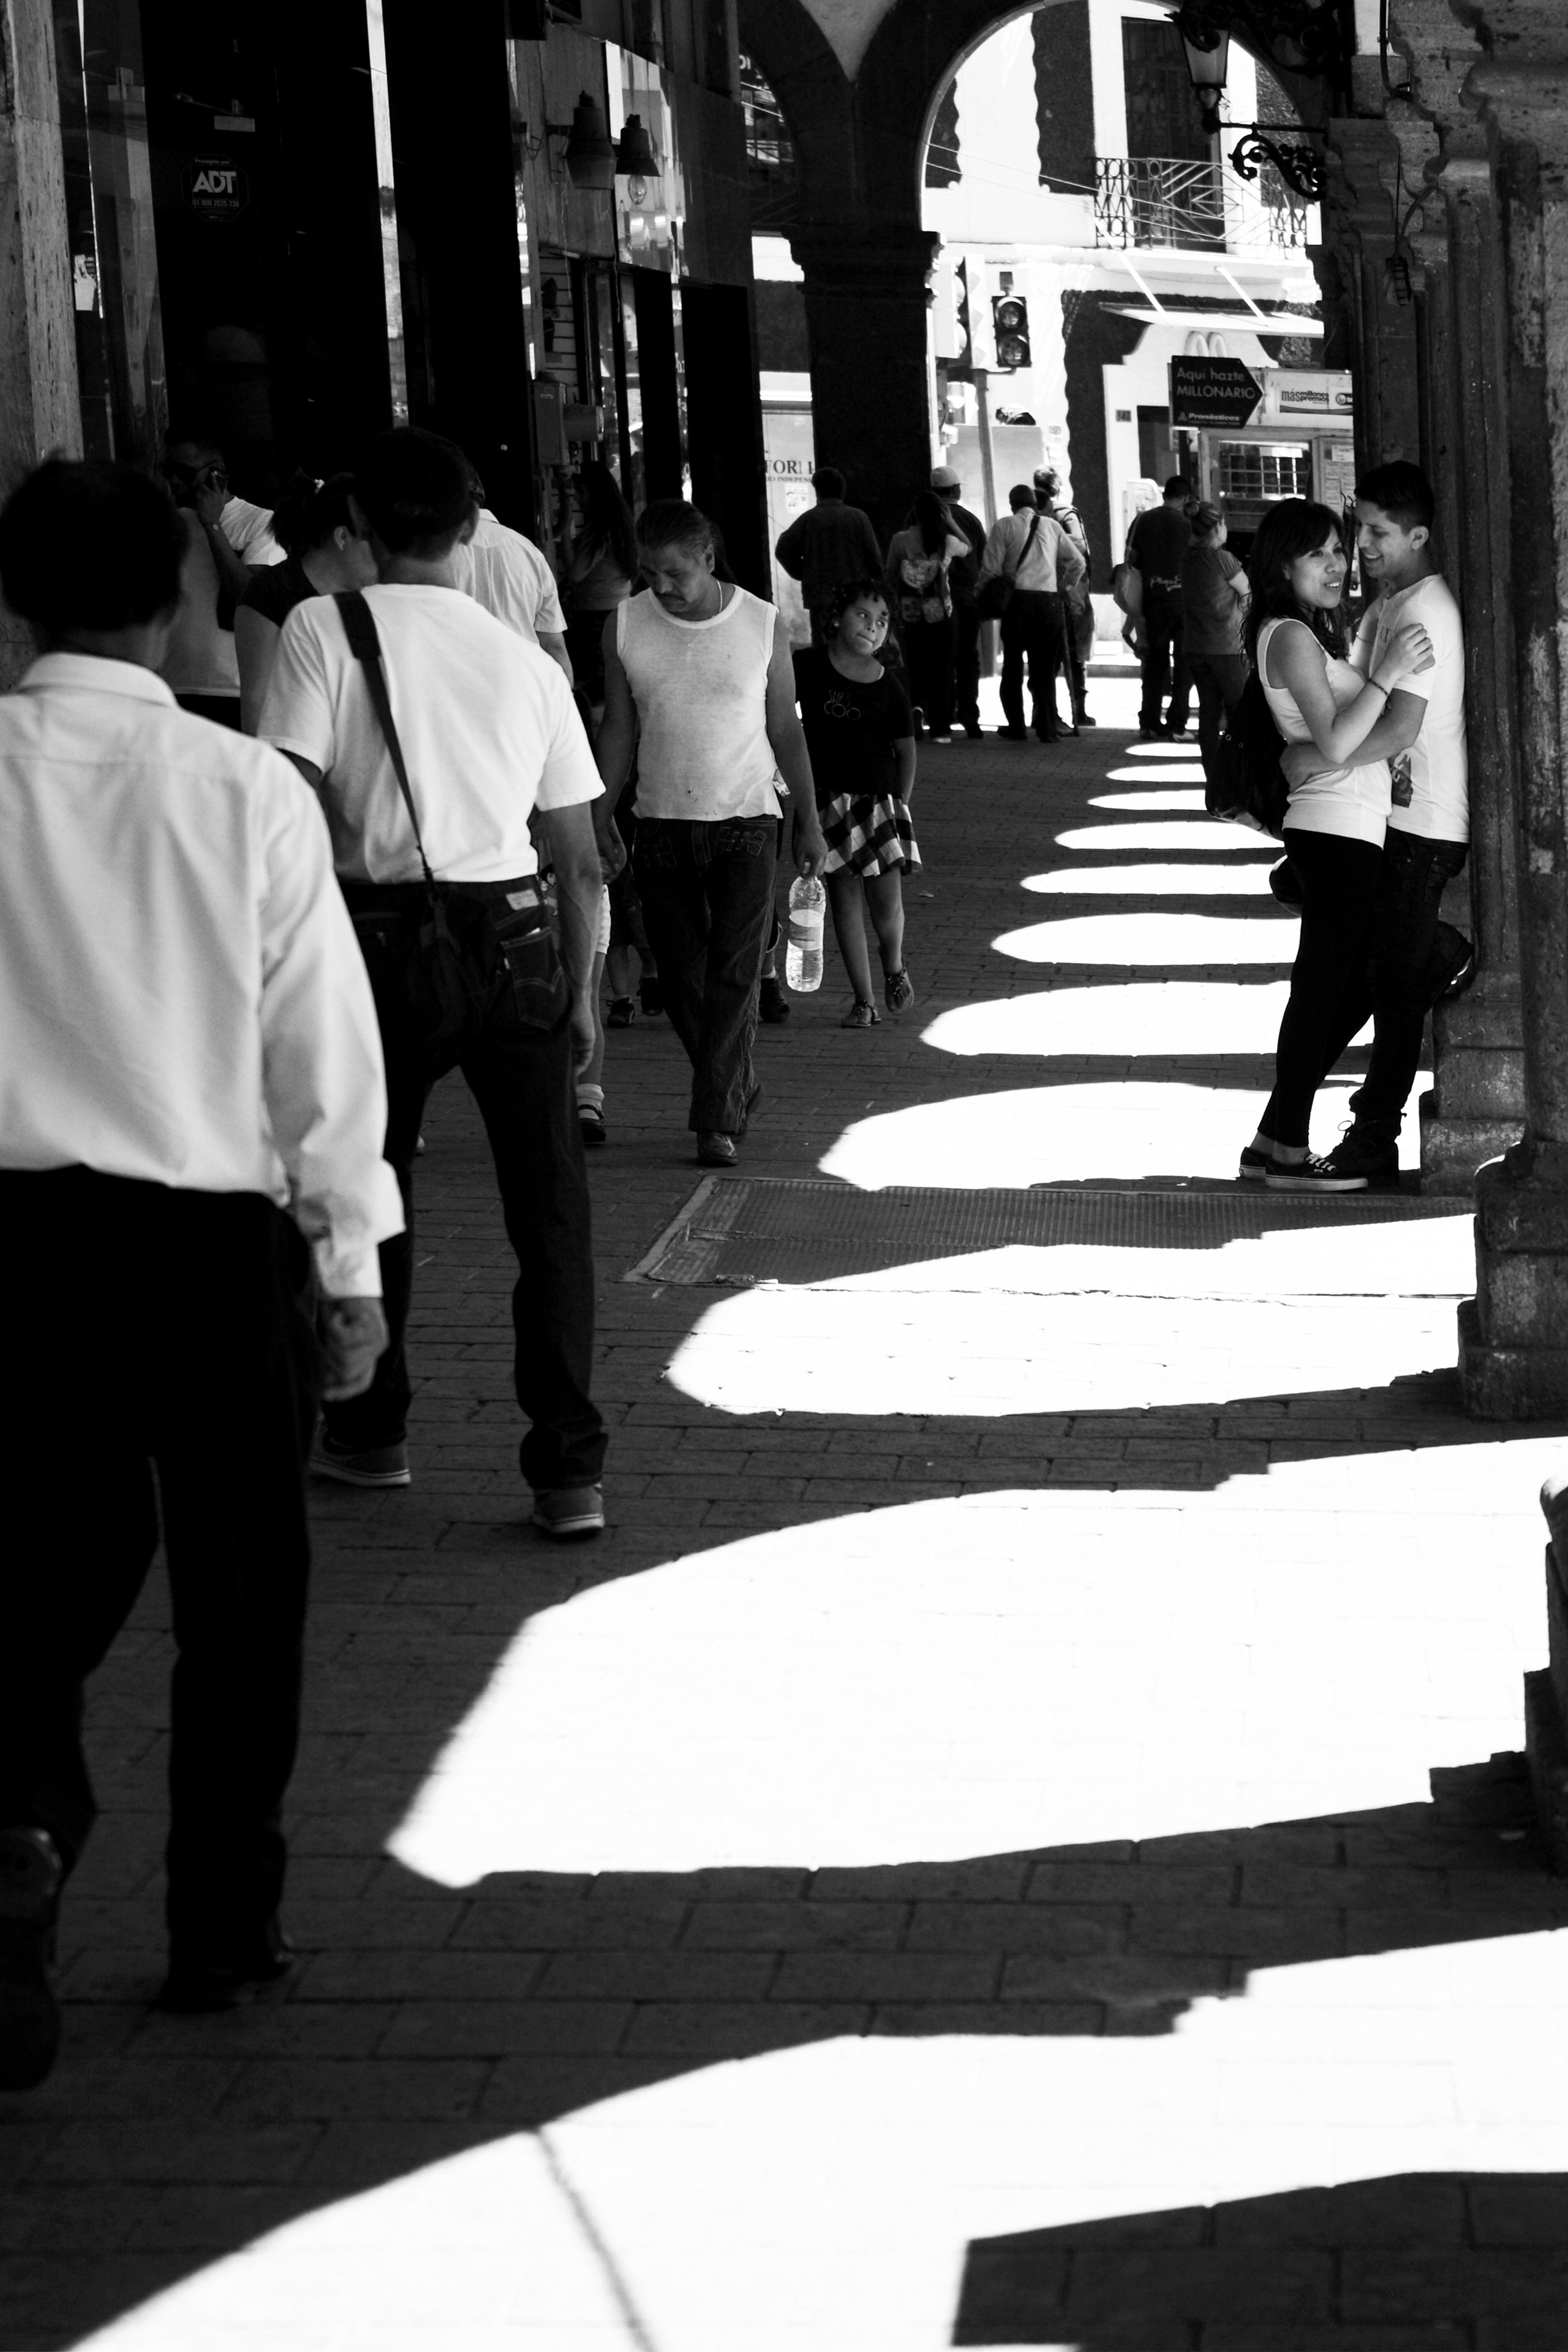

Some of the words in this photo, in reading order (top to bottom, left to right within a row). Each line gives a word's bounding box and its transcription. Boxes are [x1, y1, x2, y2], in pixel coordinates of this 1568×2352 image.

[192, 170, 237, 194] ADT
[1210, 368, 1245, 382] hazte
[1176, 385, 1256, 399] MILLONARIO
